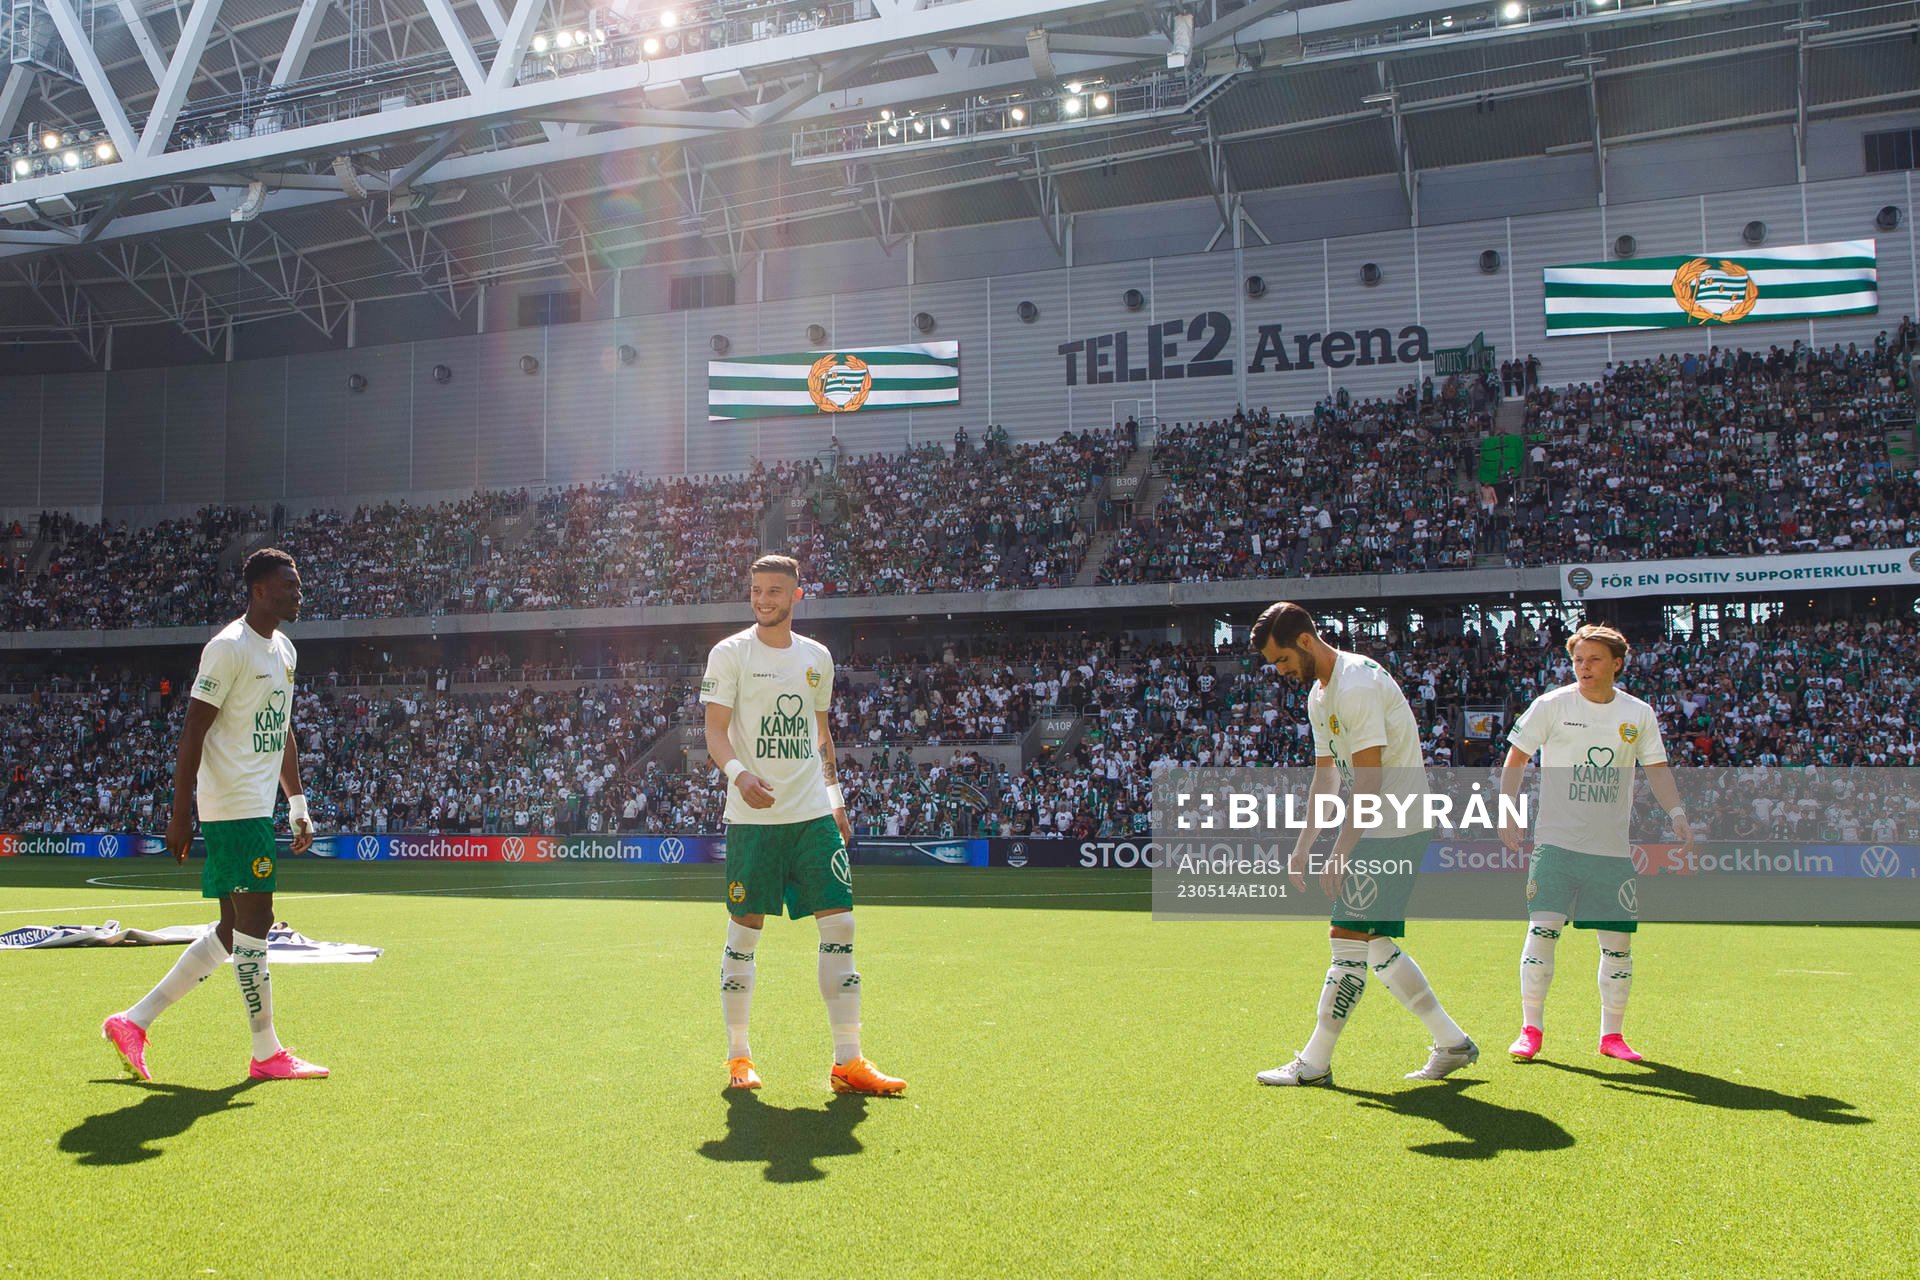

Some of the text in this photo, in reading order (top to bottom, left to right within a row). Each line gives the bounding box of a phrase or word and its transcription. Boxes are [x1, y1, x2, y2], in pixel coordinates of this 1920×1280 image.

[1058, 311, 1434, 386] TELE2 Arena
[1601, 562, 1902, 588] FÖR EN POSITIV SUPPORTERKULTUR
[761, 711, 809, 737] KÄMPA
[756, 738, 814, 759] DENNIS!
[2, 837, 86, 854] Stockholm
[389, 839, 488, 857] Stockholm
[536, 840, 642, 859] Stockholm
[1079, 842, 1280, 869] STOCKHOLM
[1439, 846, 1530, 869] Stockh
[1667, 848, 1833, 872] Stockholm
